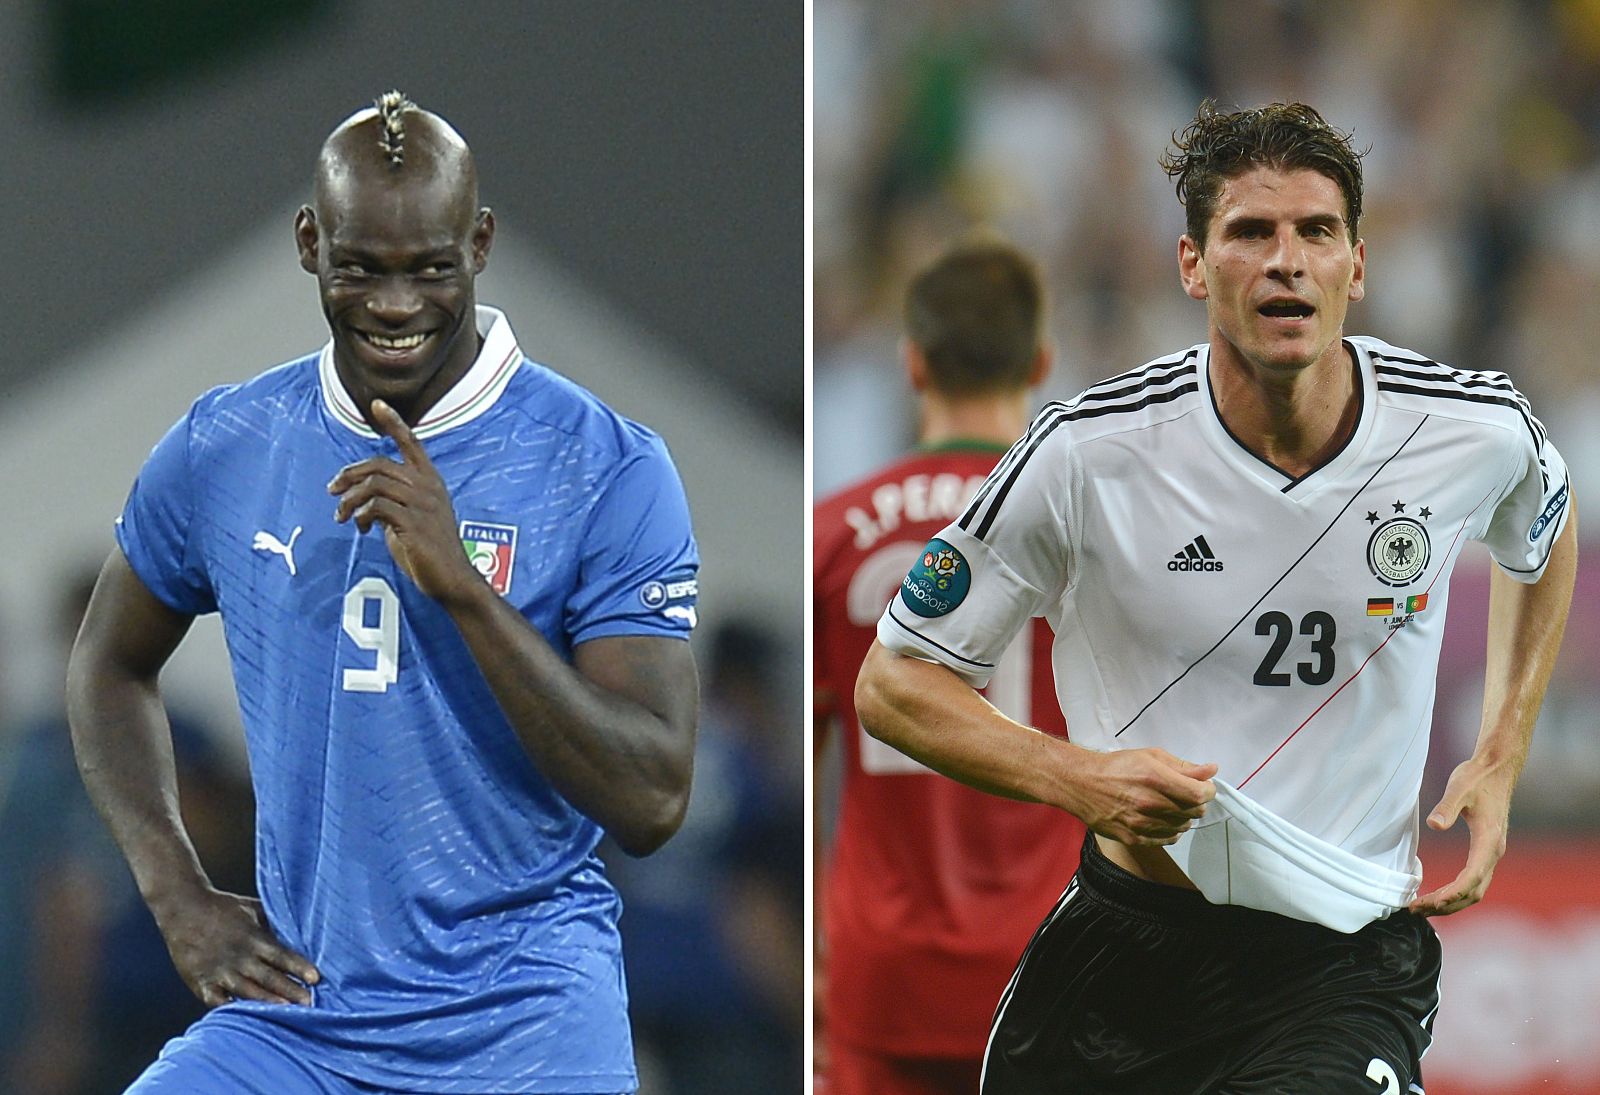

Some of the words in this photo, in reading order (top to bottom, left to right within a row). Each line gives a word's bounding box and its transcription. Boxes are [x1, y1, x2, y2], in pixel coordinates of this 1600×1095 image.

[467, 527, 510, 543] ITALIA
[1381, 525, 1419, 541] DEUTSCHER
[1167, 557, 1224, 572] adidas
[342, 576, 400, 693] 9
[1252, 610, 1337, 687] 23
